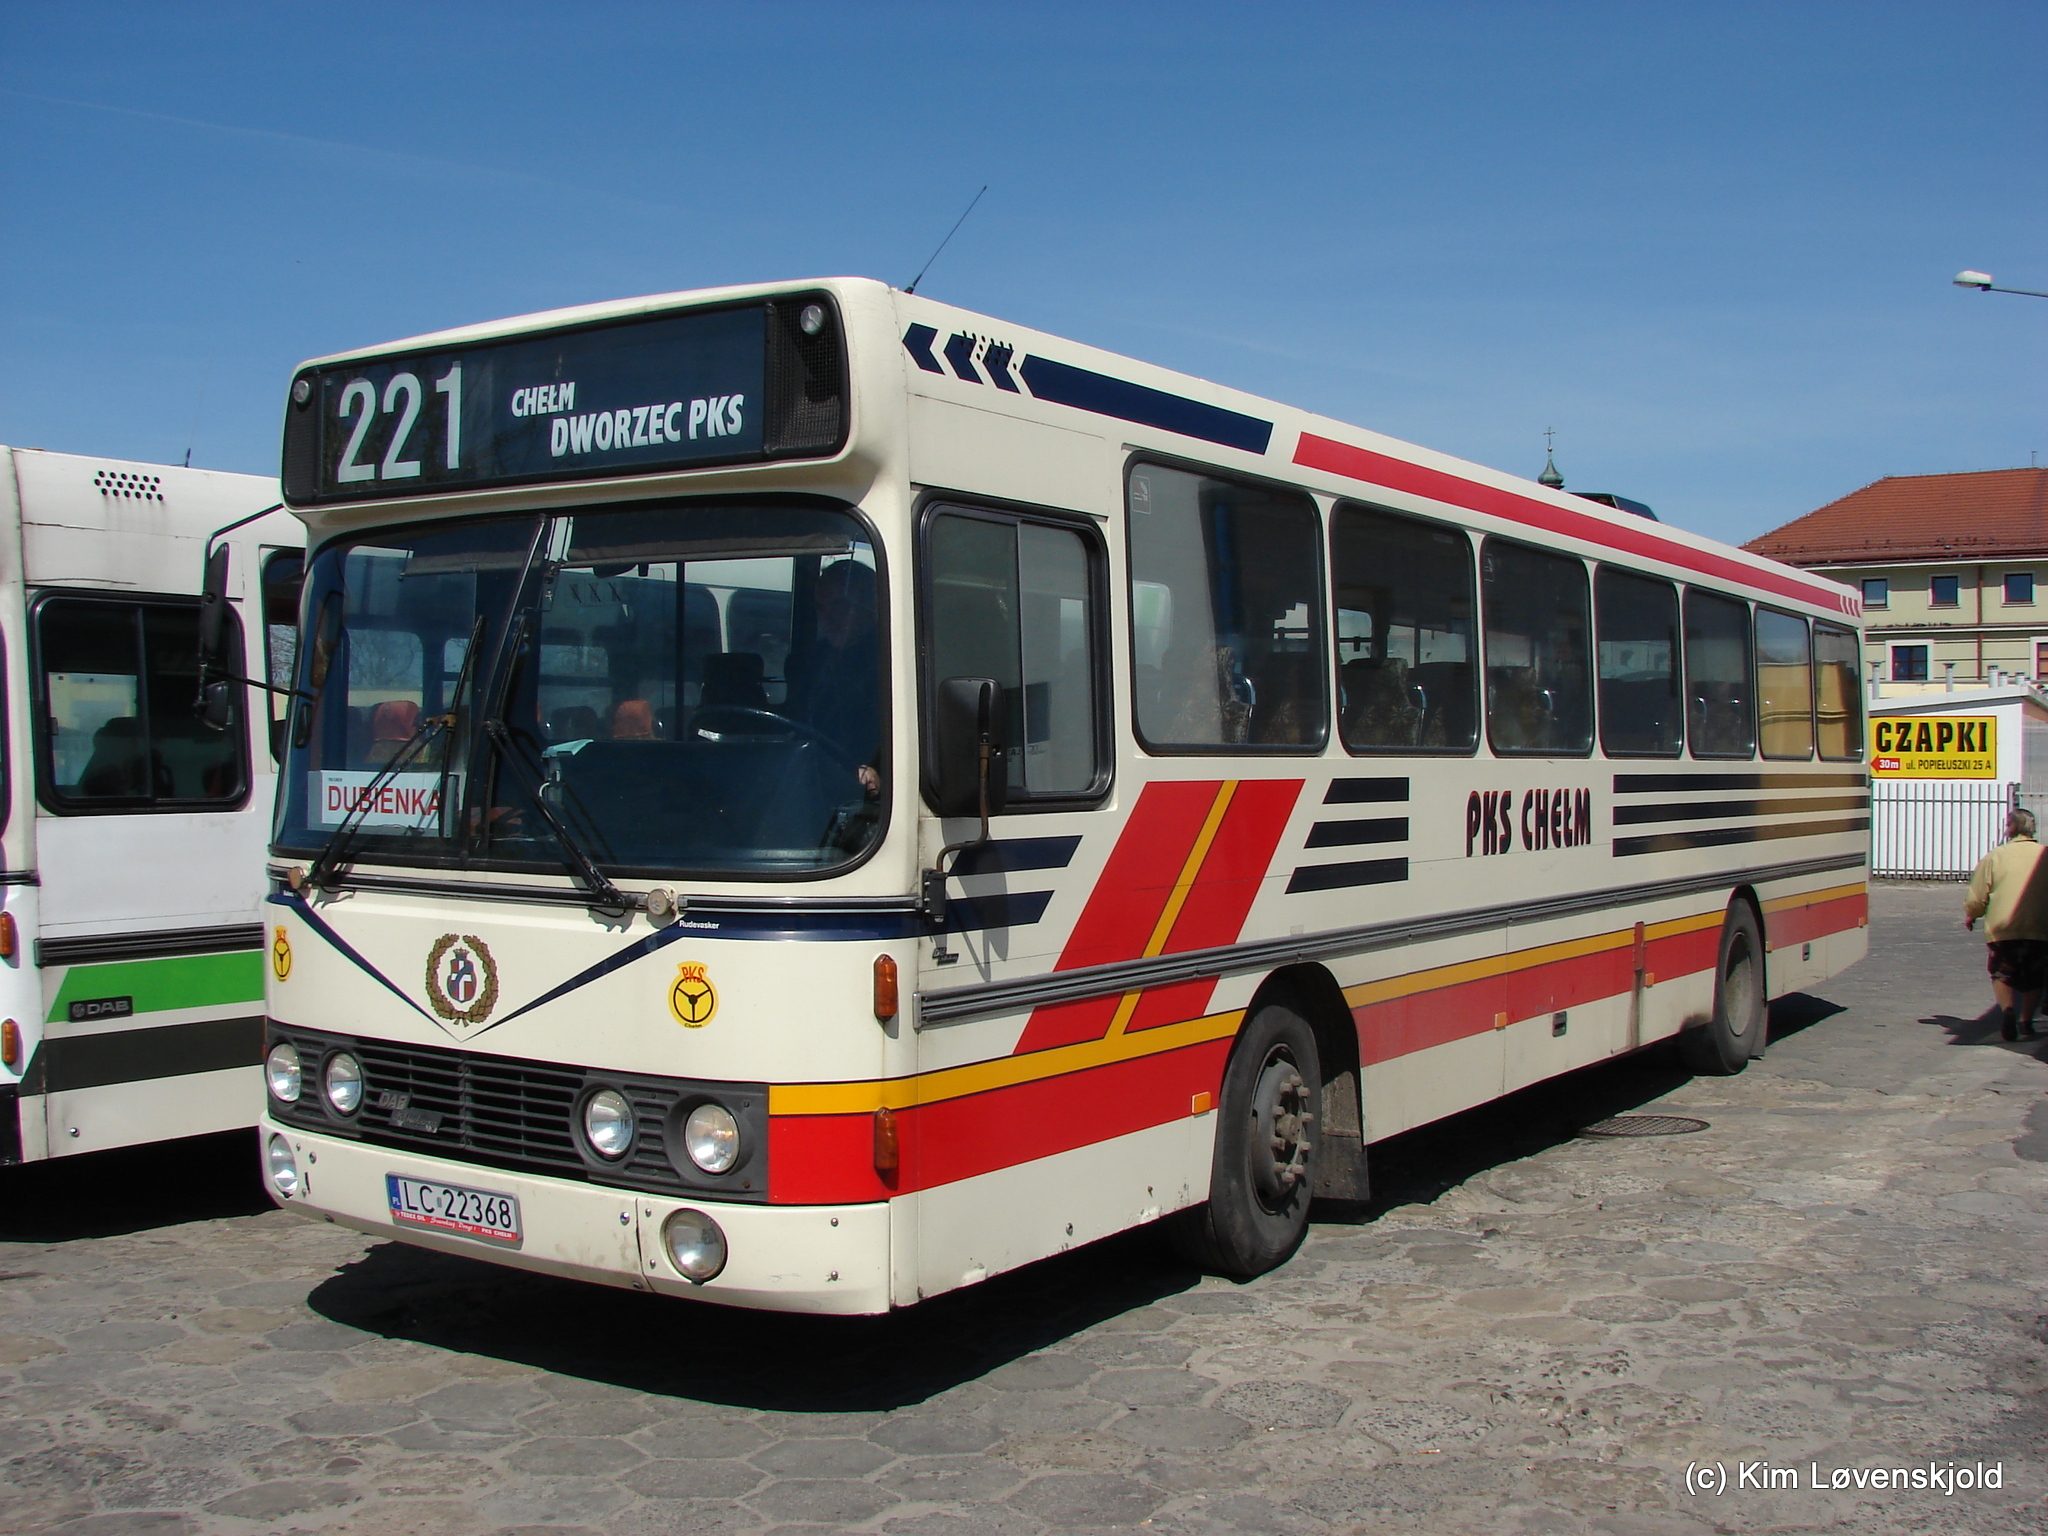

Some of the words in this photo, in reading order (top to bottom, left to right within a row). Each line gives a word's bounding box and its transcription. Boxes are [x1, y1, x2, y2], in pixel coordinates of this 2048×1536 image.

[511, 381, 576, 418] CHEŁM
[338, 361, 462, 484] 221
[550, 402, 682, 458] DWORZEC
[688, 394, 744, 440] PKS
[1875, 721, 1988, 753] CZAPKI
[1906, 760, 1915, 770] ul.
[1918, 759, 1971, 770] POPIEŁUSZKI
[1973, 760, 1983, 770] 25
[1985, 760, 1992, 770] A
[328, 785, 440, 816] DUBIENKA
[1465, 790, 1512, 858] PKS
[1521, 787, 1591, 851] CHEŁM
[681, 965, 704, 983] PKS
[87, 1001, 130, 1015] DAB
[379, 1091, 409, 1110] DAB
[404, 1181, 435, 1214] LC
[443, 1188, 512, 1229] 22368
